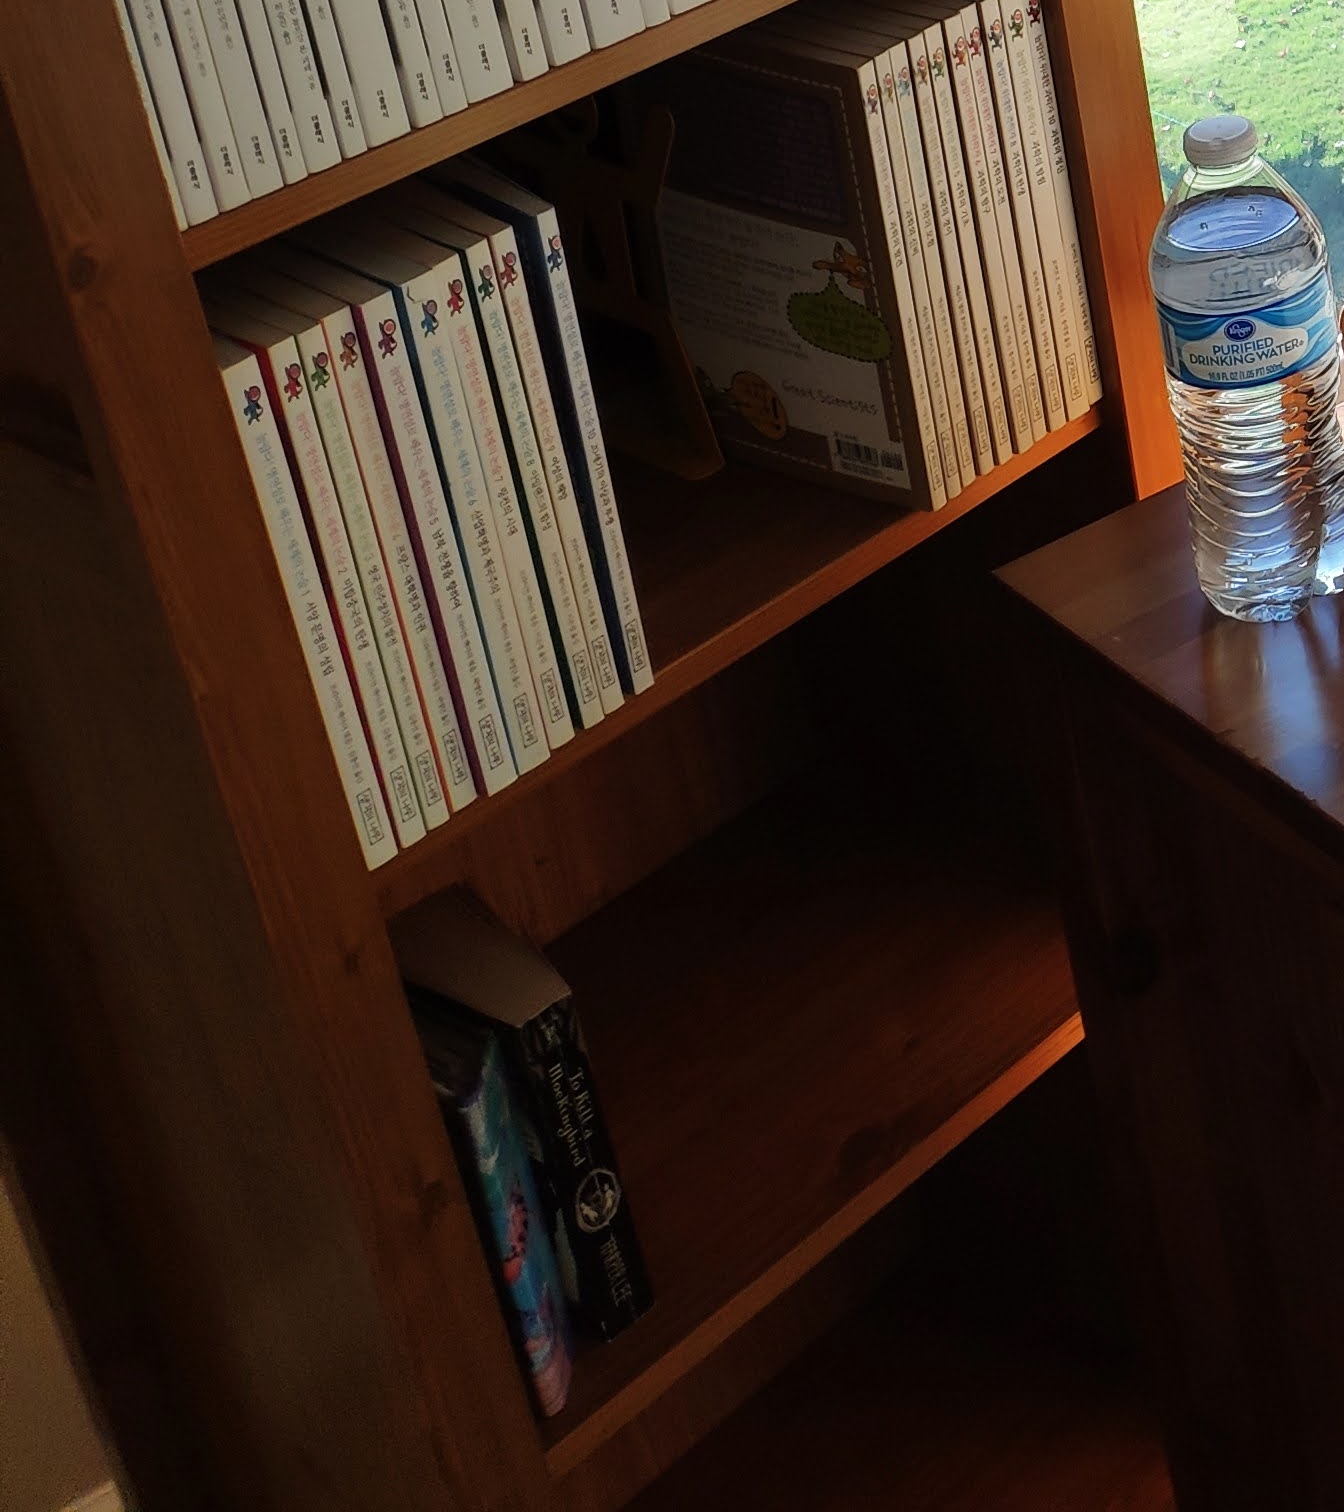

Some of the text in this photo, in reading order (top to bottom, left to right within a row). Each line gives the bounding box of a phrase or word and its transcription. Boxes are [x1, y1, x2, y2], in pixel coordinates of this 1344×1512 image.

[1049, 128, 1061, 154] 과학의
[1189, 338, 1299, 367] DRINKING WATER
[1212, 337, 1274, 355] PURIFIED
[1229, 370, 1239, 380] OZ
[303, 601, 319, 622] 서양
[310, 622, 328, 654] 문명의
[569, 1067, 584, 1090] To
[571, 1090, 593, 1123] Kill
